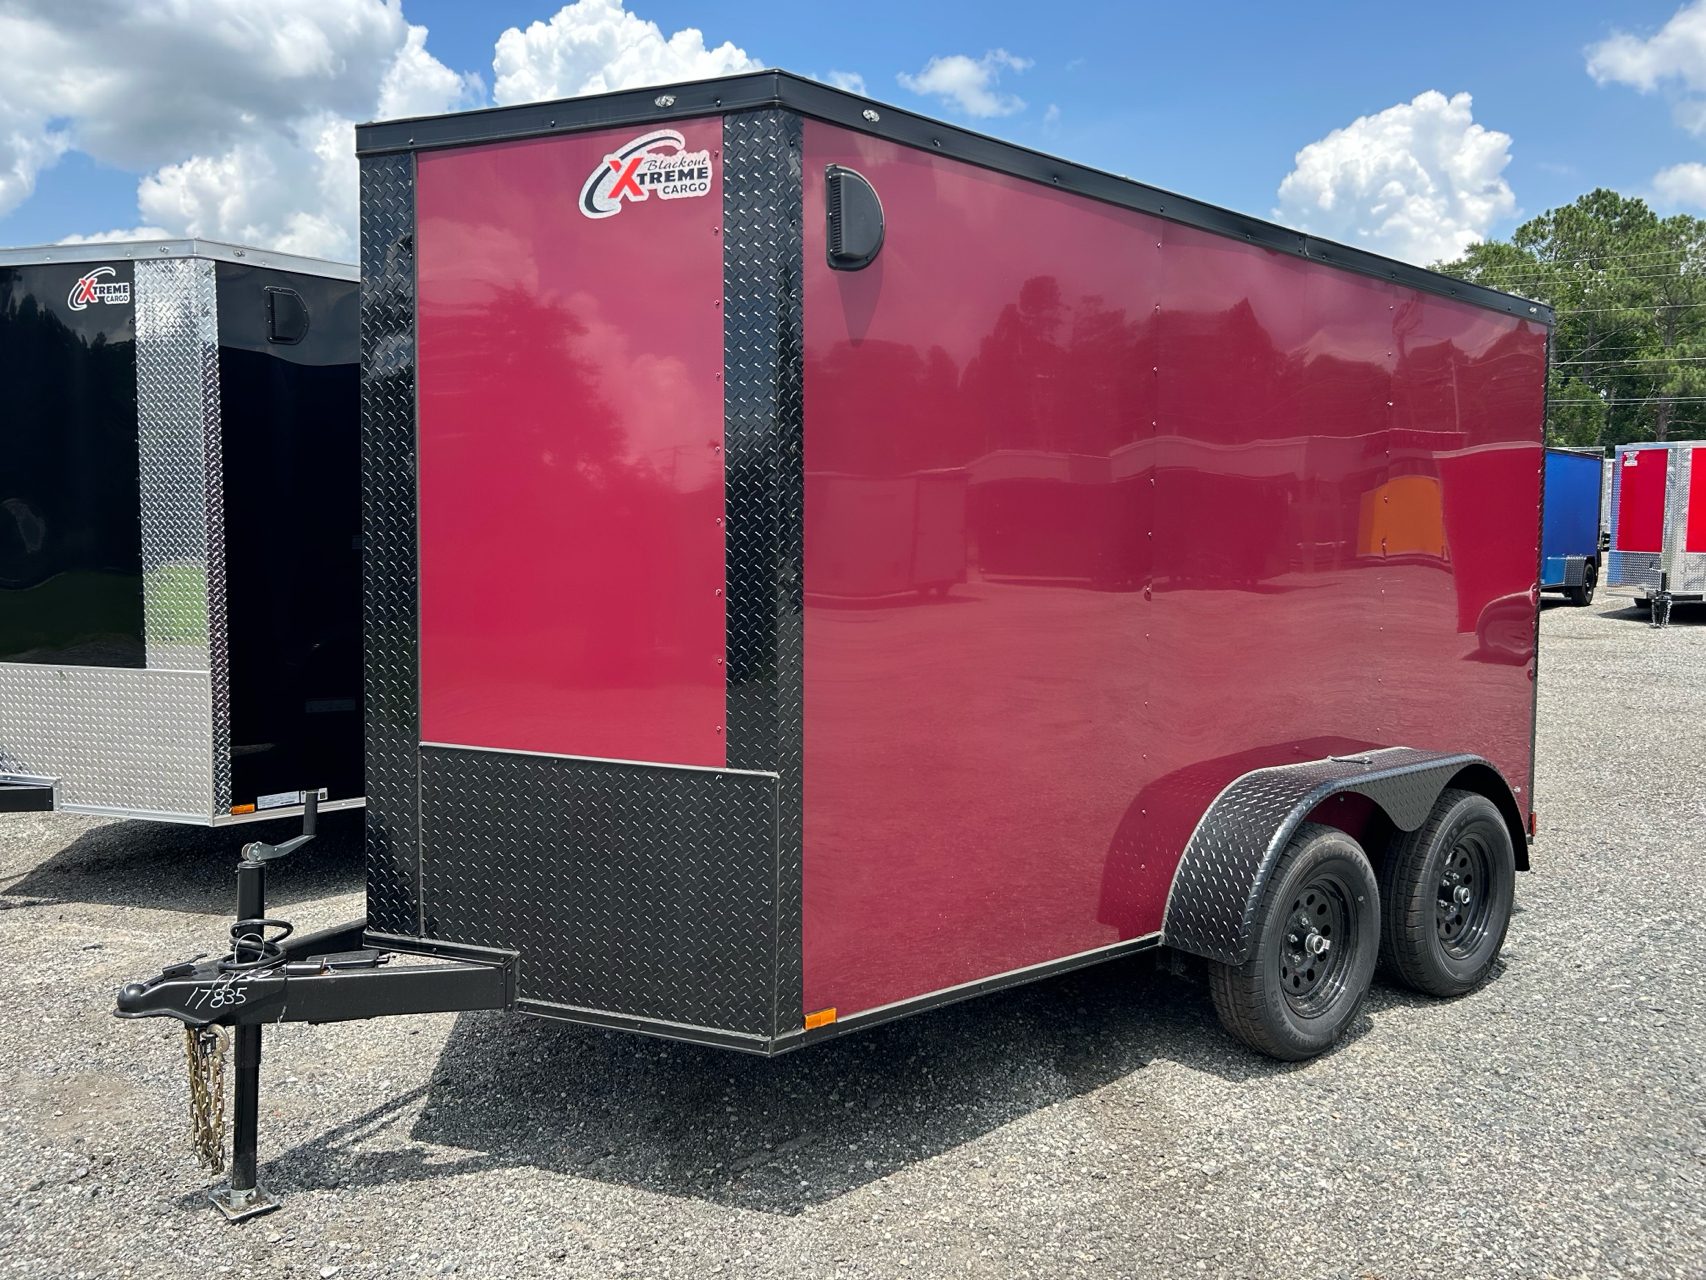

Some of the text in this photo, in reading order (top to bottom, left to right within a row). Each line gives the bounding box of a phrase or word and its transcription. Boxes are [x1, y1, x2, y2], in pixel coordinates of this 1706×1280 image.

[644, 156, 707, 171] Blackout
[608, 157, 709, 198] XTREME
[662, 182, 707, 195] CARGO
[79, 279, 129, 302] XTREME
[105, 294, 129, 303] CARGO
[185, 986, 248, 1010] 17835
